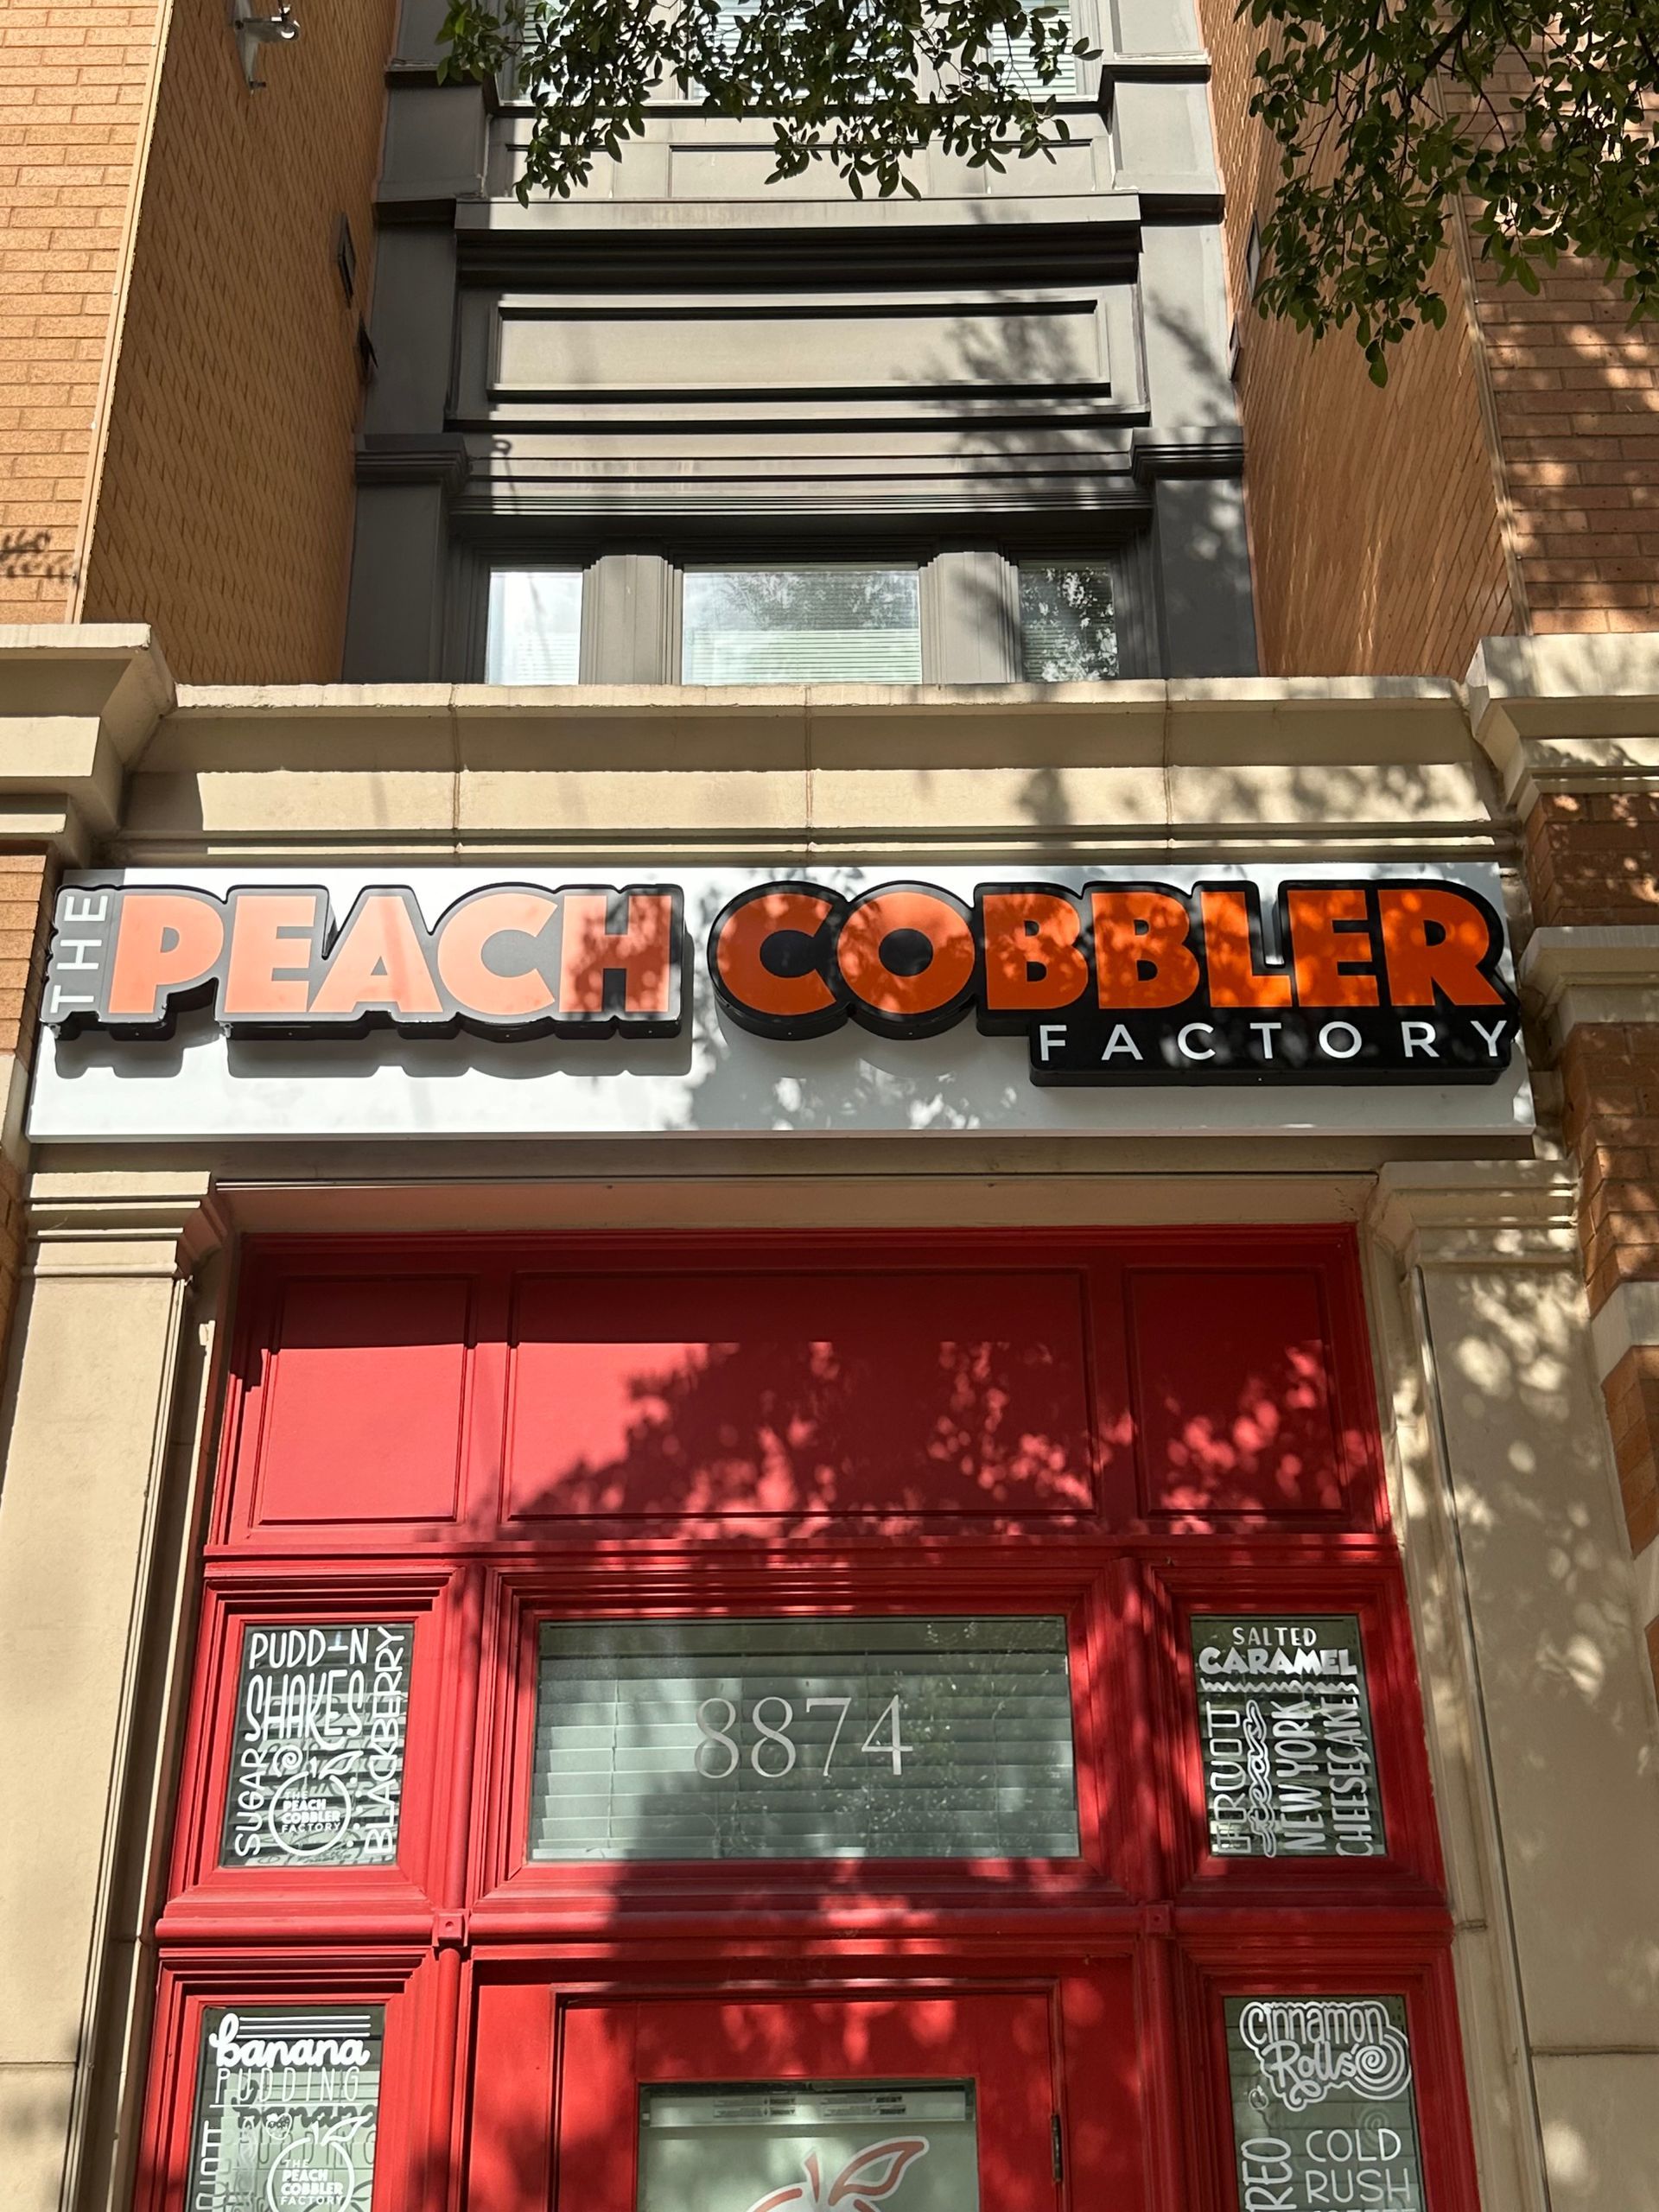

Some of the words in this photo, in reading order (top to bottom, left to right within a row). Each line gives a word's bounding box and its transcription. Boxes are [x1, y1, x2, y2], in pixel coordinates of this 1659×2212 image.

[50, 894, 108, 1014] THE
[107, 893, 673, 1015] PEACH
[716, 888, 1507, 1017] COBBLER
[1039, 1019, 1509, 1062] FACTORY
[1232, 1626, 1318, 1647] SALTED
[1198, 1646, 1358, 1676] CARAMEL
[245, 1669, 365, 1751] SHAKES
[364, 1625, 405, 1855] BLACKBERRY
[693, 1694, 914, 1780] 8874
[1270, 1700, 1319, 1778] YORK
[284, 1790, 309, 1800] THE
[1321, 1696, 1375, 1857] CHEESECAKE
[234, 1746, 269, 1857] SUGAR
[282, 1810, 341, 1825] COBBLER
[283, 1799, 327, 1812] PEACH
[1277, 1783, 1327, 1851] NEW
[281, 1822, 341, 1834] FACTORY
[208, 2012, 372, 2069] banana
[215, 2065, 360, 2104] PUDDING
[1306, 2127, 1402, 2163] COLD
[280, 2182, 344, 2196] COBBLER
[282, 2169, 329, 2182] PEACH
[1305, 2167, 1413, 2204] RUSH
[279, 2195, 344, 2206] FACTORY
